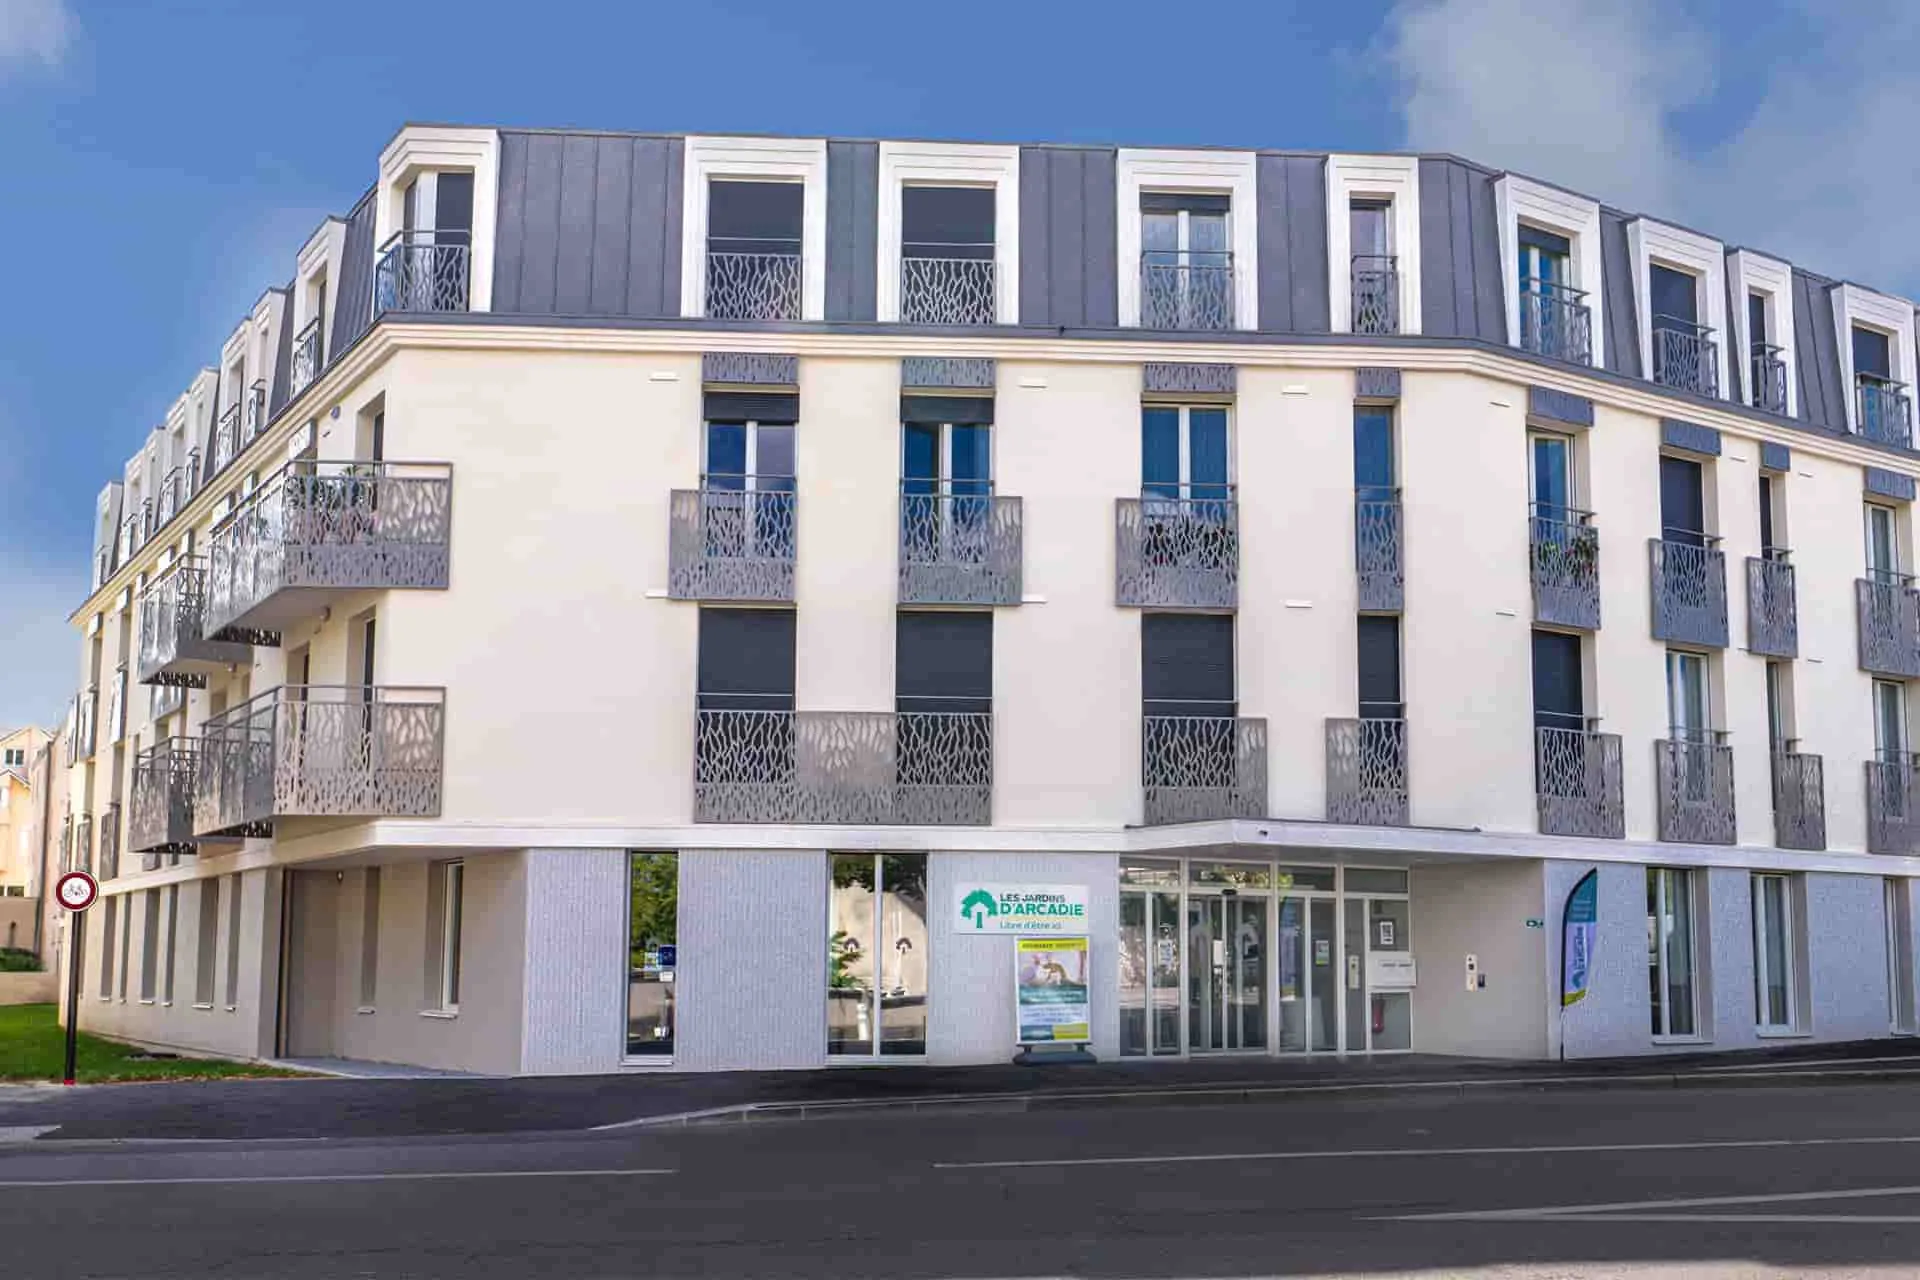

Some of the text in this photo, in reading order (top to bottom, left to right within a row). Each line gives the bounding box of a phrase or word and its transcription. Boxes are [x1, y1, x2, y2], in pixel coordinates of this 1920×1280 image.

[1000, 894, 1066, 903] LES JARDINS
[1000, 903, 1084, 916] D'ARCADIE
[1000, 921, 1021, 930] Libre
